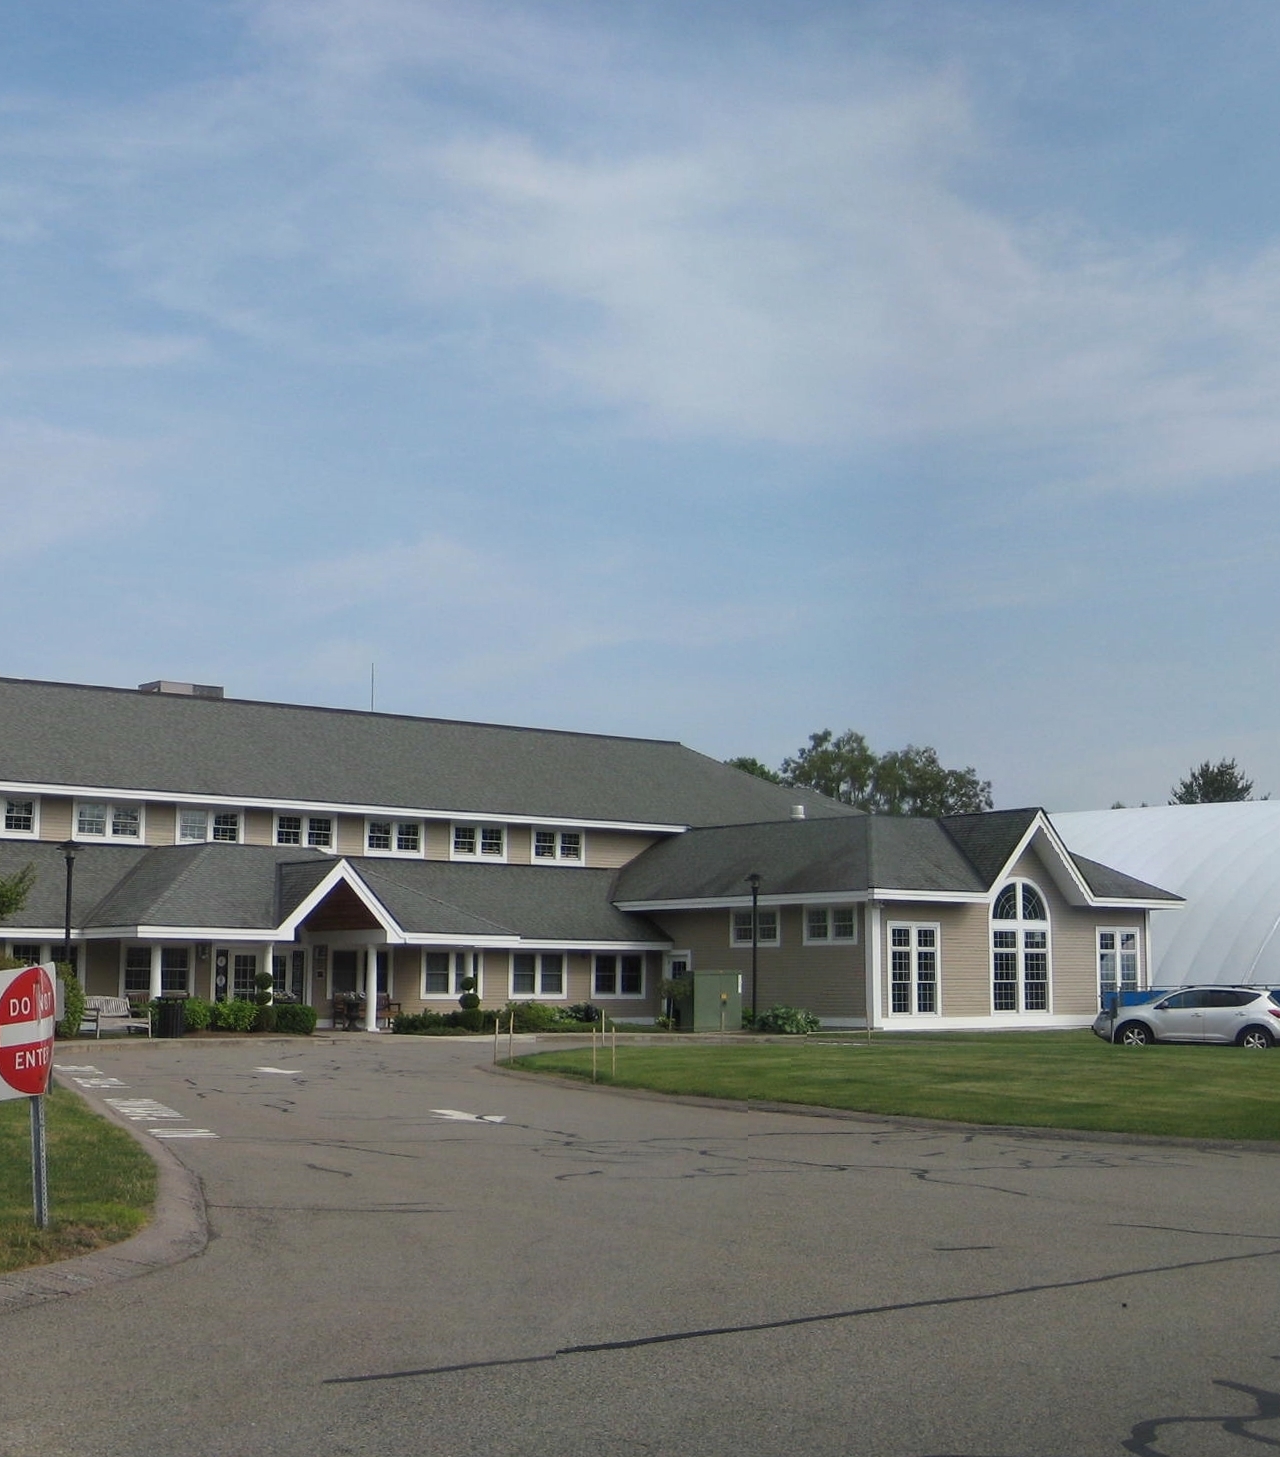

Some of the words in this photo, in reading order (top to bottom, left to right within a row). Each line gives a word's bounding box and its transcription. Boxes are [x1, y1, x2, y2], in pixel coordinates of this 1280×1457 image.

[10, 997, 31, 1017] DO
[36, 992, 52, 1014] NOT
[15, 1046, 49, 1070] ENTER
